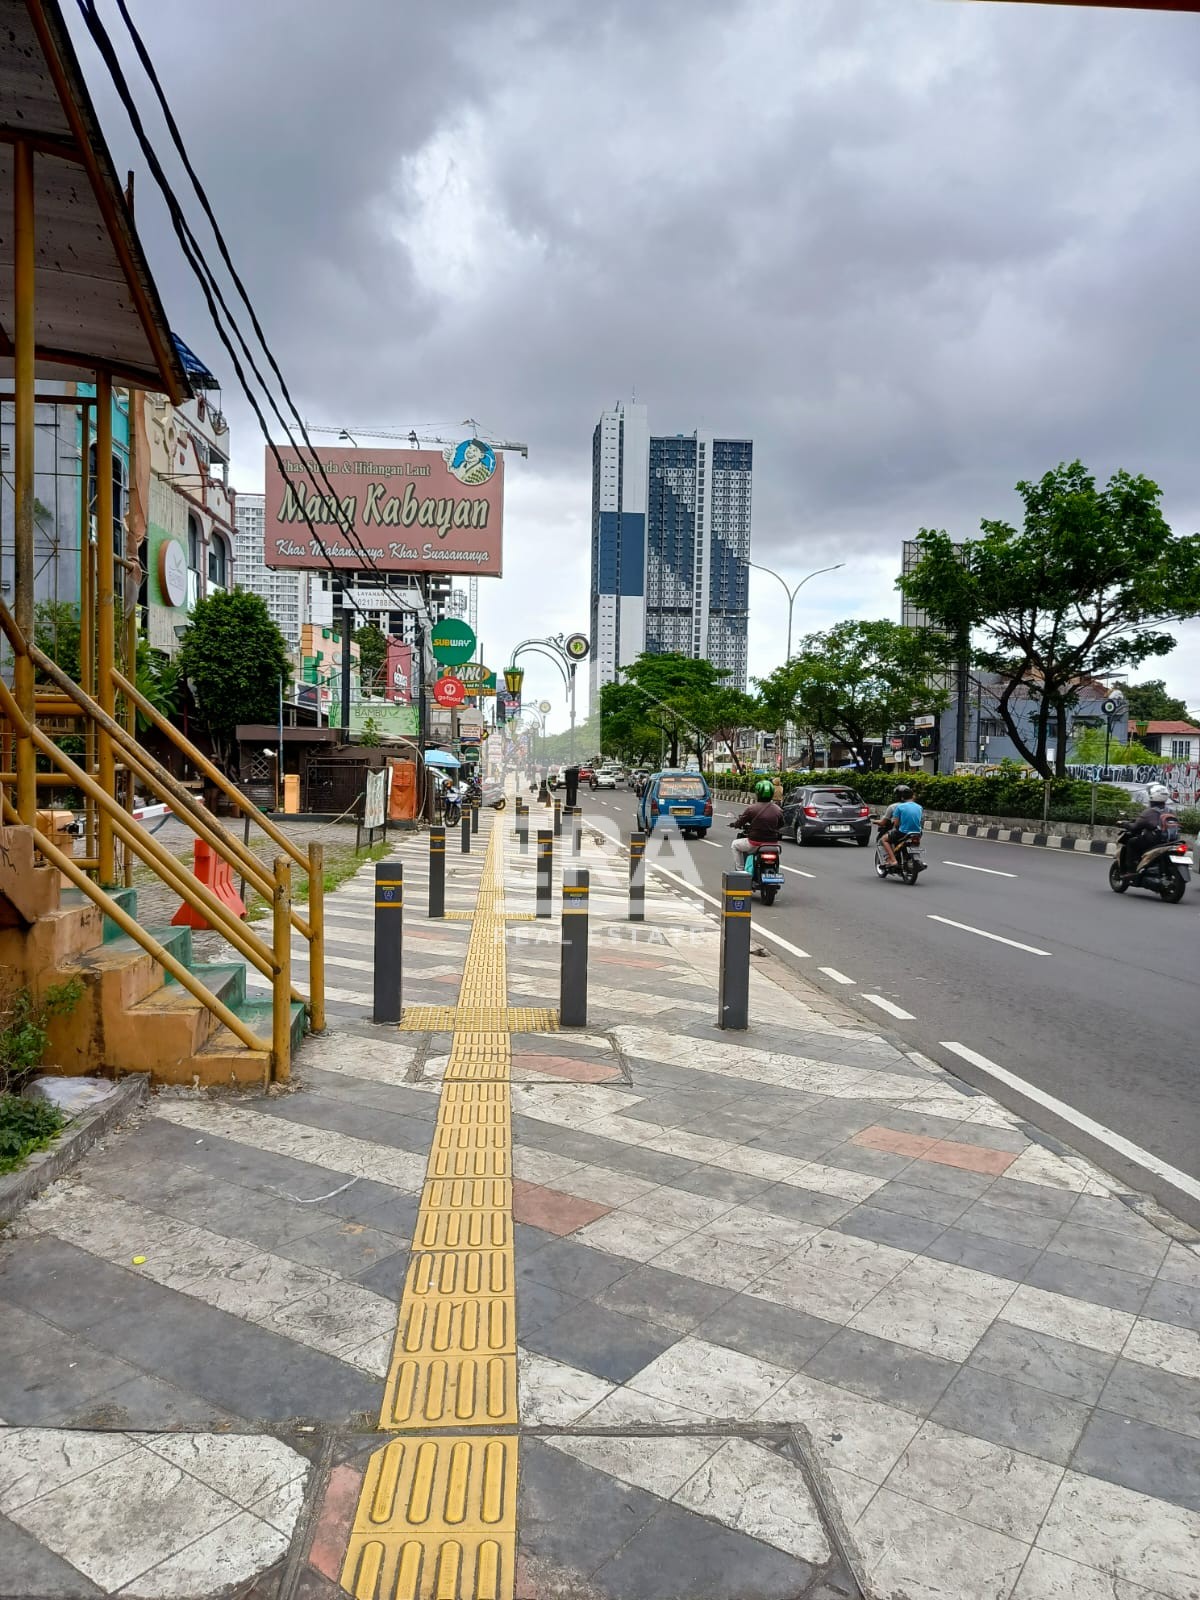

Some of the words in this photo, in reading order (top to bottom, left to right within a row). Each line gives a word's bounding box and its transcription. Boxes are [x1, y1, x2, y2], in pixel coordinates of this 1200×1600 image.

[278, 458, 303, 472] has
[342, 462, 352, 474] &
[354, 462, 402, 477] Hidangan
[405, 464, 431, 477] Laut
[277, 481, 357, 533] Mang
[363, 482, 490, 538] Kabayan
[275, 539, 306, 556] Khas
[389, 542, 419, 561] Khas
[423, 543, 490, 564] Suasananya
[432, 638, 471, 647] SUBWAY
